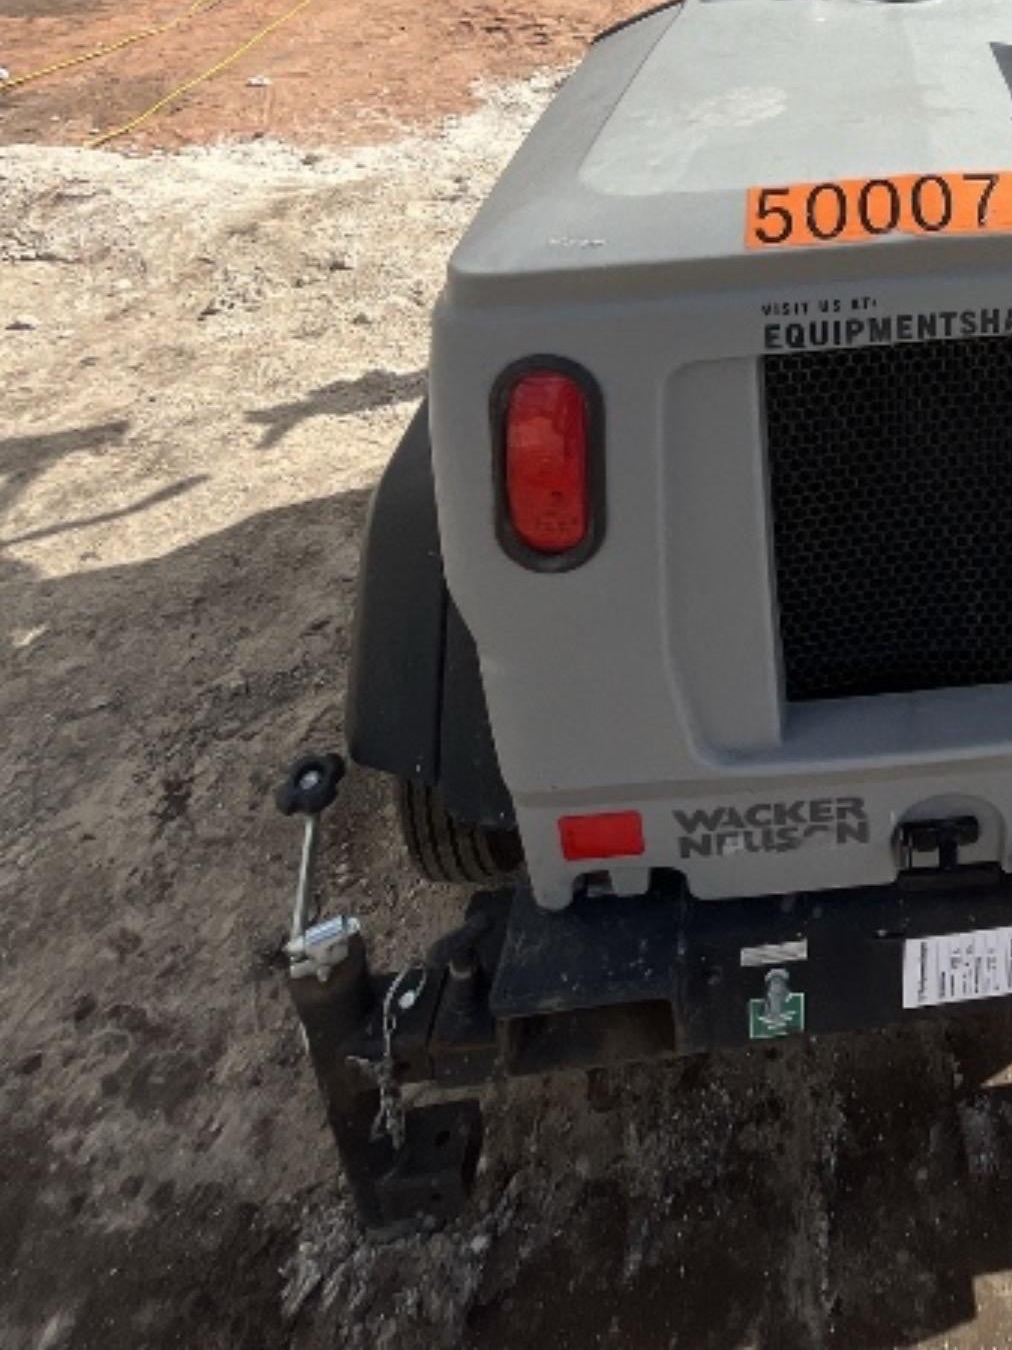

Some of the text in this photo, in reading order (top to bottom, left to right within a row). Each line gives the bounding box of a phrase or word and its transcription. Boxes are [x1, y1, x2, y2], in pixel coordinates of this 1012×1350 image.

[761, 302, 809, 317] VISIT
[818, 299, 842, 314] US
[671, 796, 868, 835] WACKER
